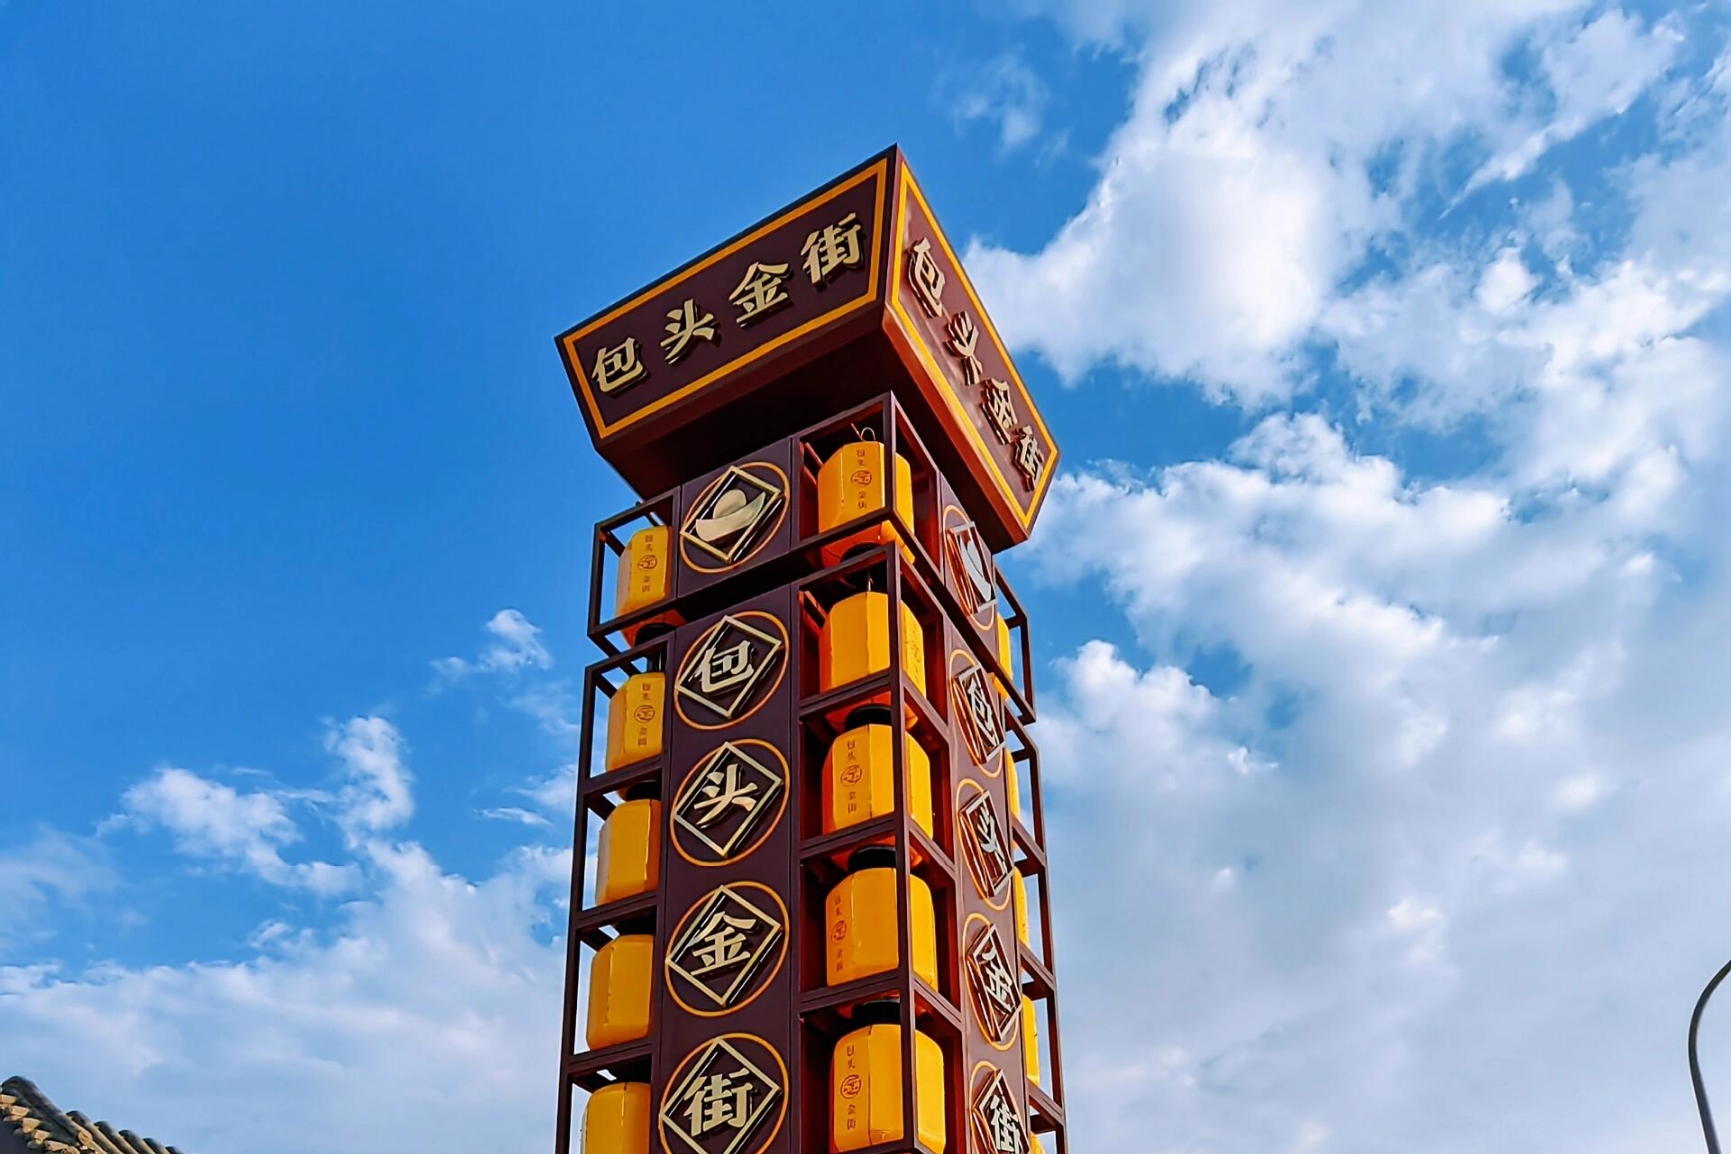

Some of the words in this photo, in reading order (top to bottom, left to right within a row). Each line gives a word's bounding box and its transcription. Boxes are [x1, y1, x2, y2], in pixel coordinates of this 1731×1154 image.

[591, 211, 868, 396] 包头金街
[908, 236, 1046, 493] 包头金街
